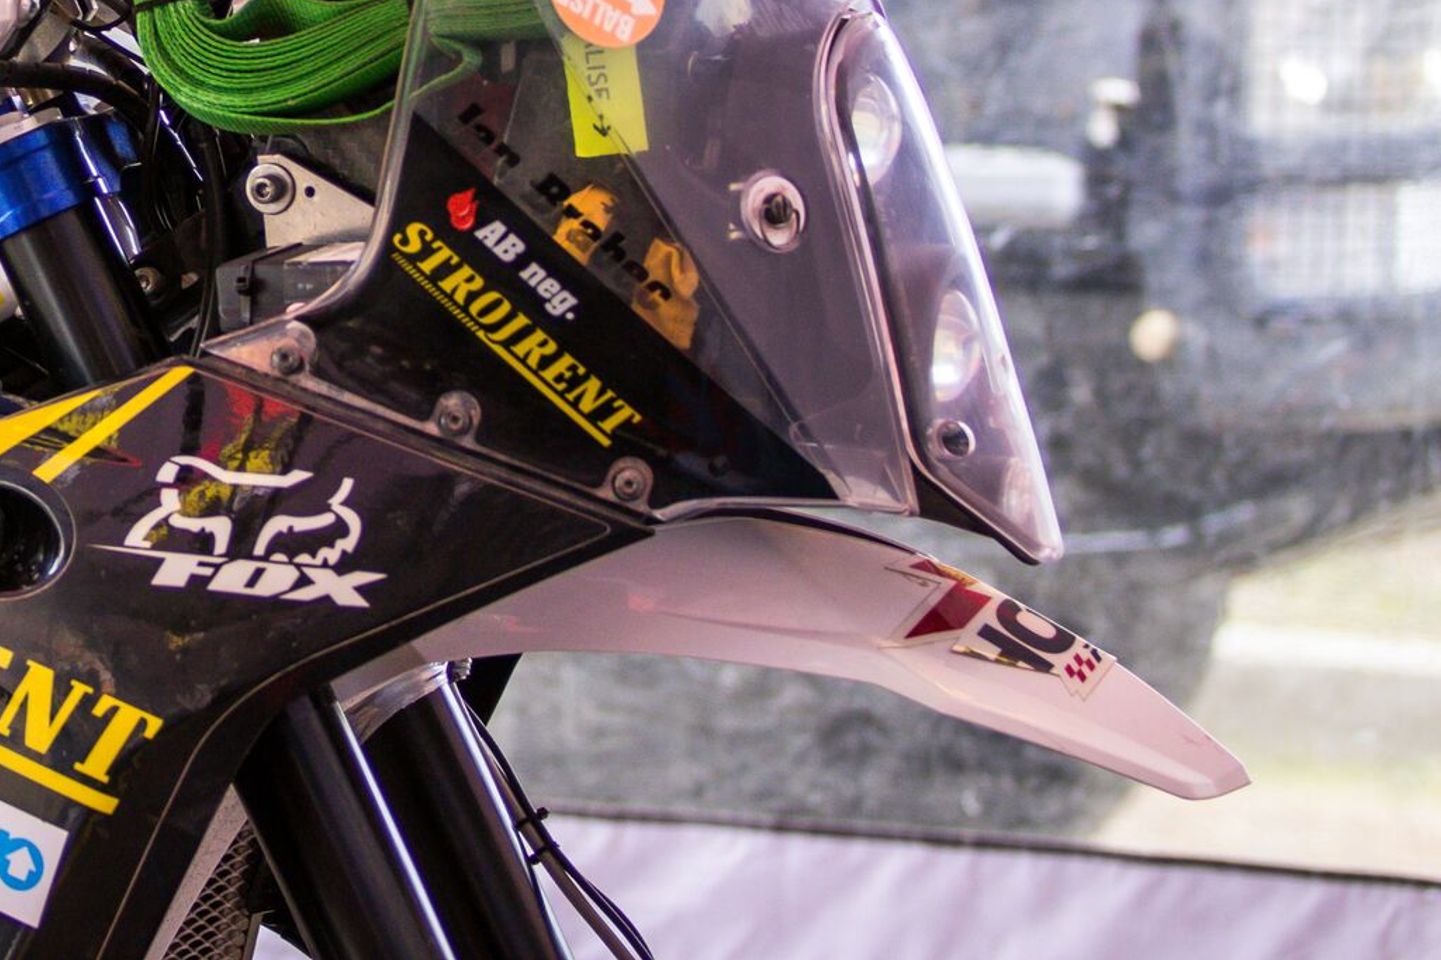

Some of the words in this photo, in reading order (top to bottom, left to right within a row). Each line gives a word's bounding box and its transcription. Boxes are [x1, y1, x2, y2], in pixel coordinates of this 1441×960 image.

[473, 220, 526, 263] AB
[518, 262, 579, 321] neg.
[392, 221, 643, 435] STROJRENT
[87, 544, 388, 608] FOX
